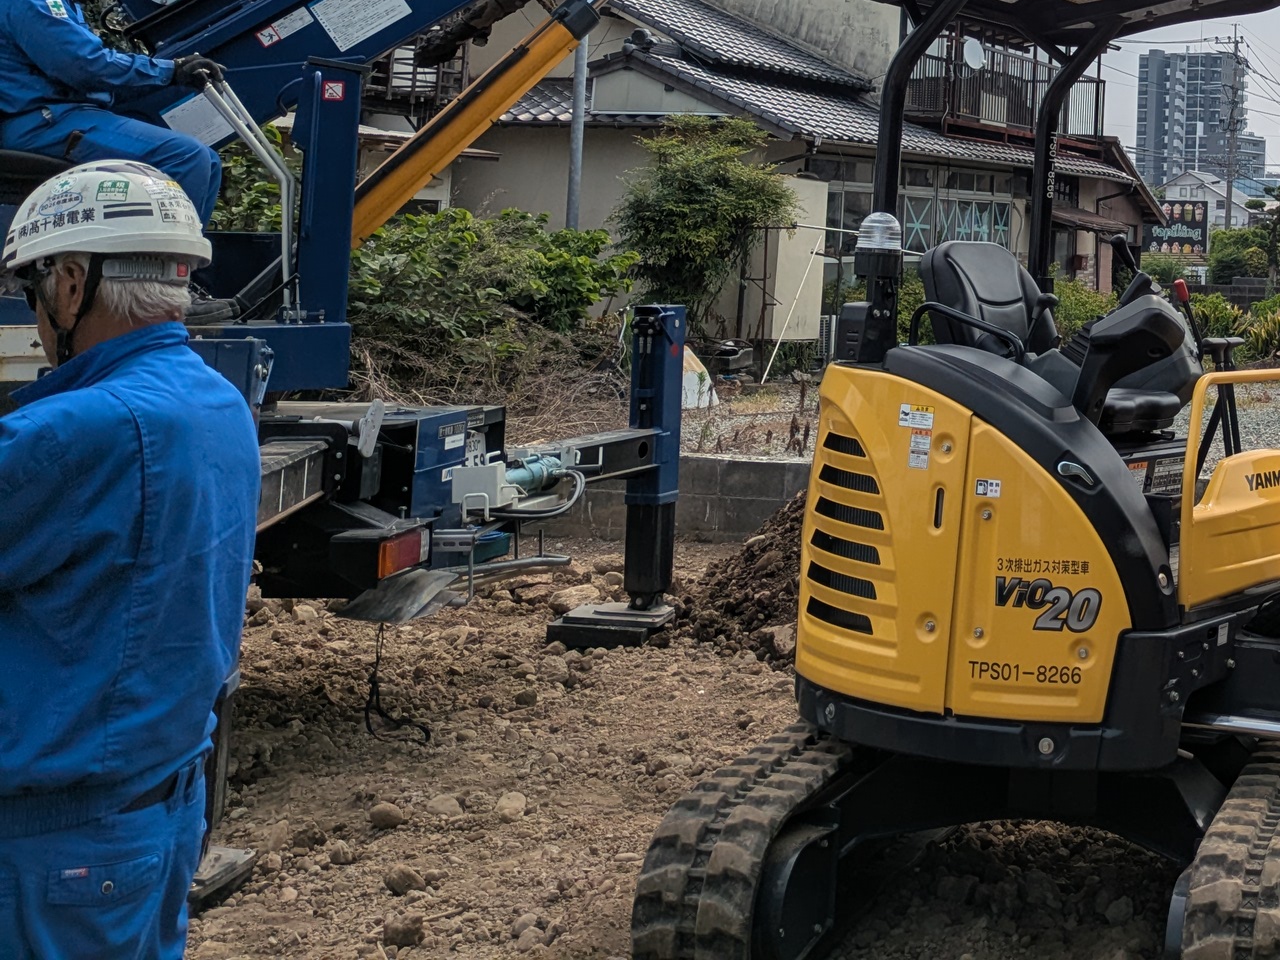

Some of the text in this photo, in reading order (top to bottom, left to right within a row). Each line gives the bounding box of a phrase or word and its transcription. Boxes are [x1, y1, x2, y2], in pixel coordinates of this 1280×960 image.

[997, 558, 1090, 575] 3次排出ガス対策型車
[969, 661, 1082, 684] TPS01-8266
